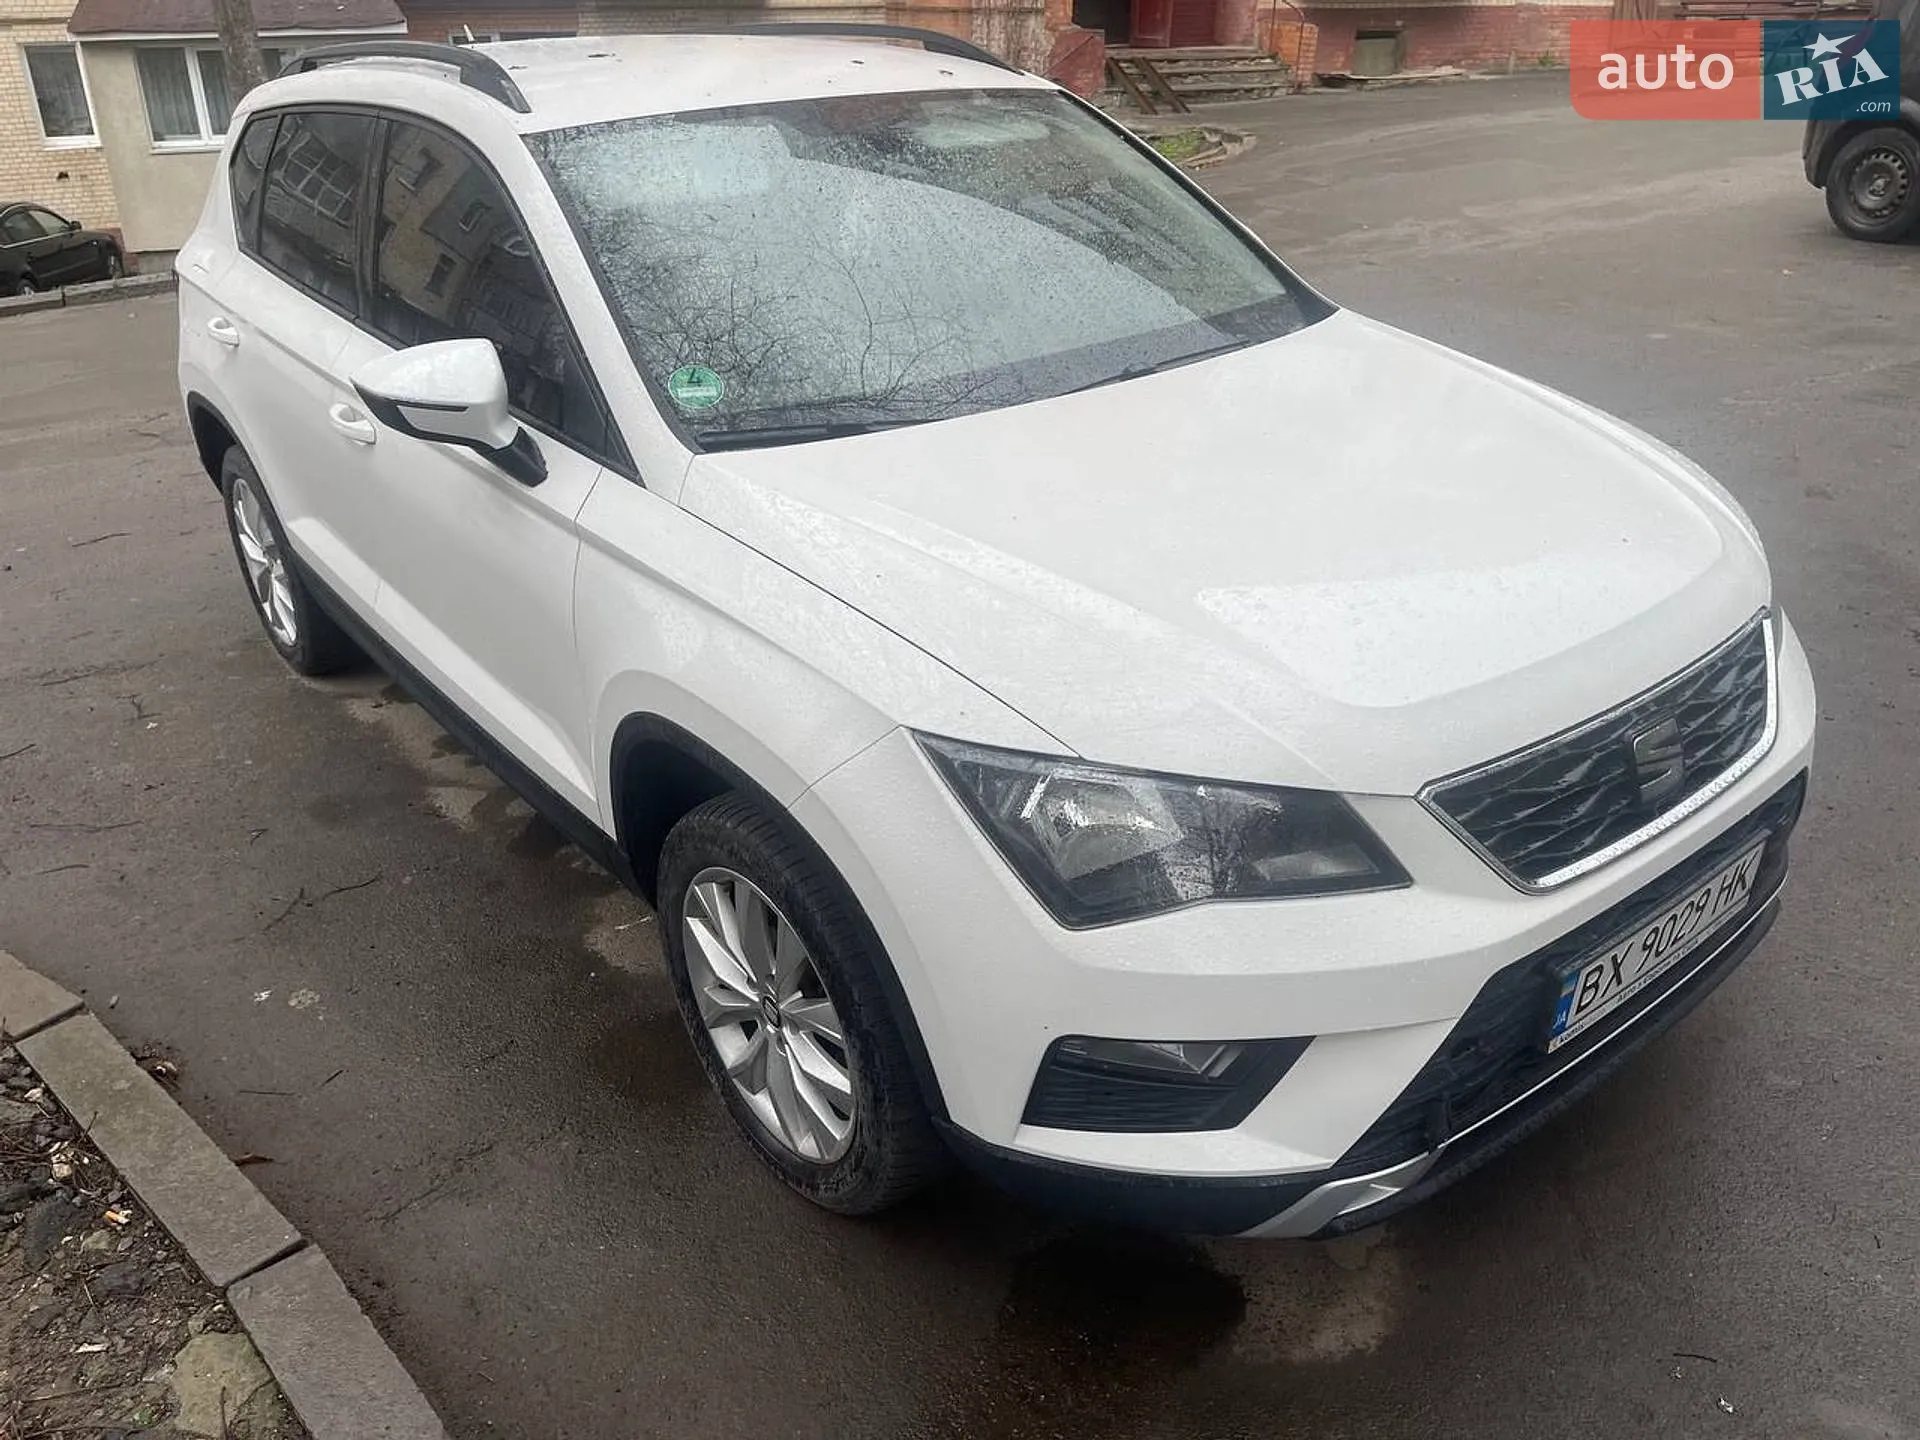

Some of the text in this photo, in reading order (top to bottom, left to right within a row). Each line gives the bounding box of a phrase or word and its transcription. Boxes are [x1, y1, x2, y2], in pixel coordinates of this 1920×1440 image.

[1575, 942, 1634, 1015] BX
[1636, 888, 1711, 973] 9029
[1712, 851, 1757, 915] HK
